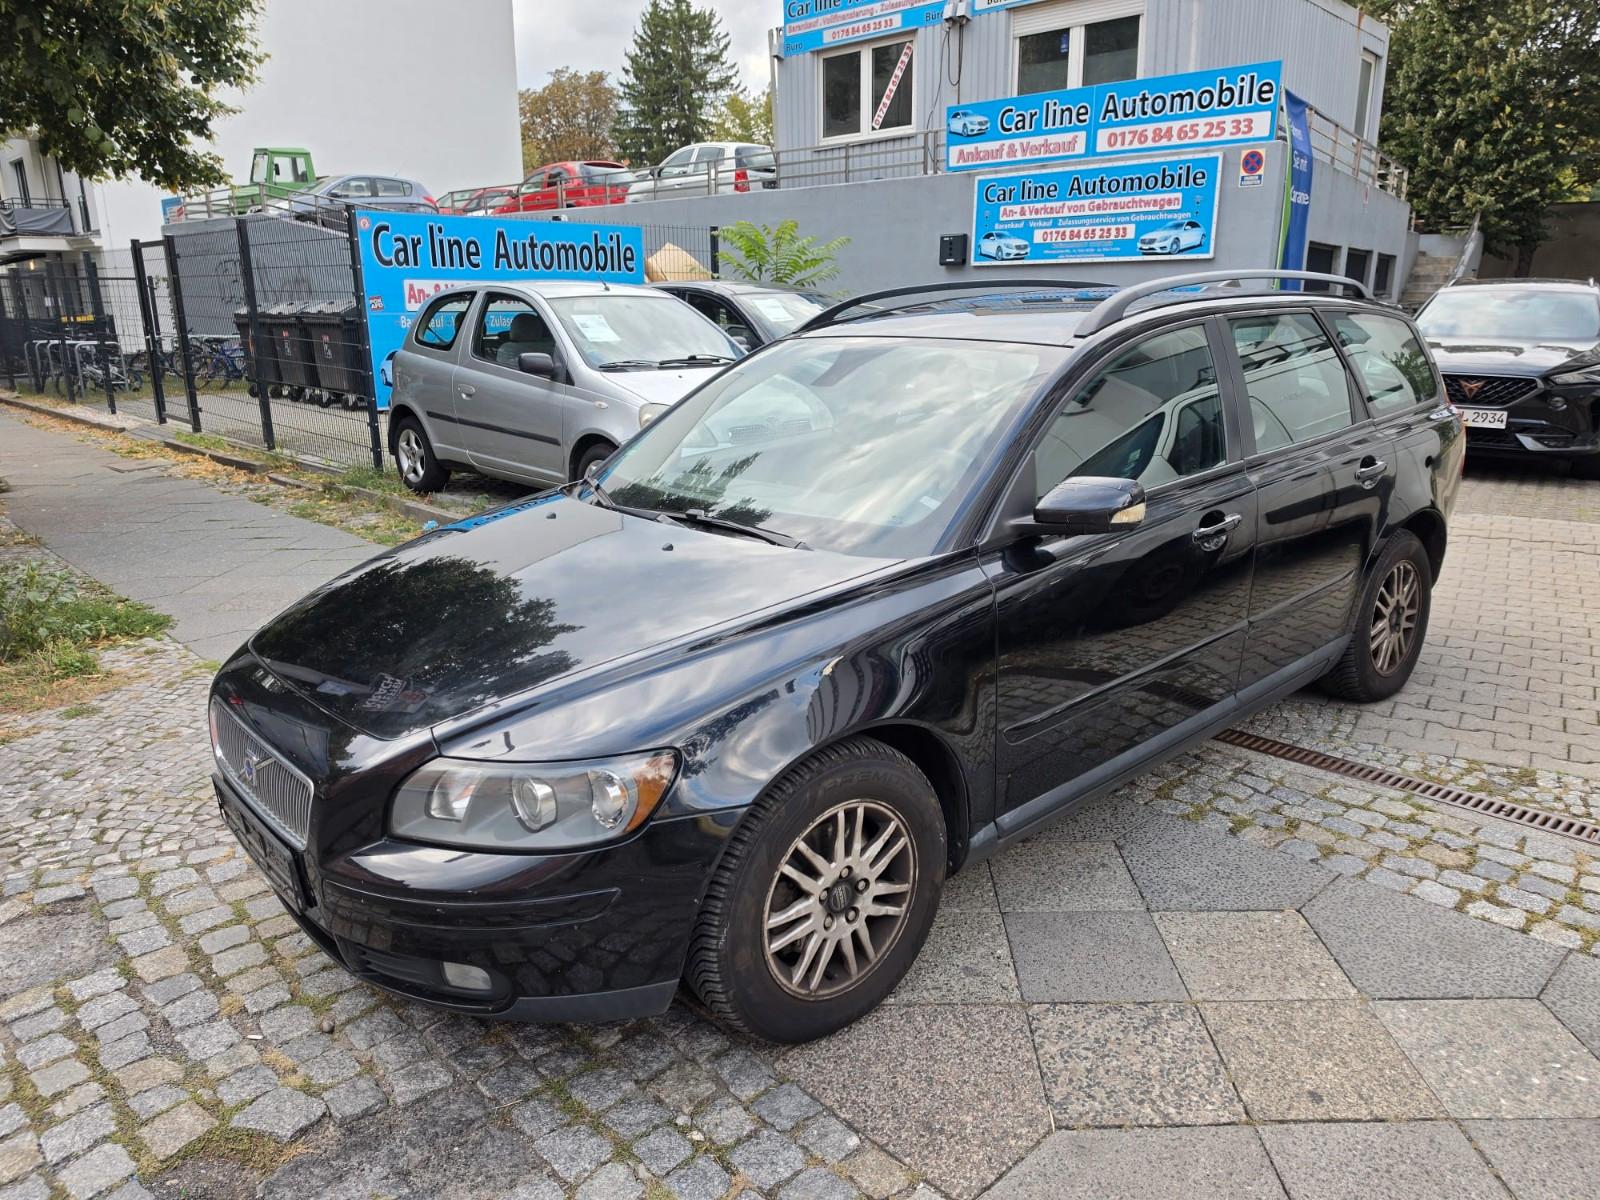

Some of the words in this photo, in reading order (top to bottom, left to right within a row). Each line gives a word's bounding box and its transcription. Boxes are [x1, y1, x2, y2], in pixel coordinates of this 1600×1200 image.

[787, 1, 811, 18] Car
[832, 28, 850, 40] 0176
[851, 25, 860, 35] 84
[862, 23, 871, 33] 65
[873, 21, 882, 31] 25
[884, 18, 893, 29] 33
[999, 107, 1038, 133] Car
[1044, 100, 1090, 128] line
[1100, 74, 1275, 121] Automobile
[1107, 129, 1149, 148] 0176
[1151, 126, 1174, 143] 84
[1177, 123, 1199, 141] 65
[1202, 120, 1226, 139] 25
[1229, 118, 1254, 136] 33
[956, 143, 1005, 164] Ankauf
[1006, 142, 1018, 158] &
[1020, 134, 1078, 157] Verkauf
[984, 184, 1015, 203] Car
[1021, 179, 1058, 200] line
[1067, 164, 1207, 197] Automobile
[1001, 207, 1018, 218] An-
[1019, 206, 1027, 217] &
[1028, 203, 1066, 216] Verkauf
[1067, 204, 1086, 213] von
[1087, 196, 1181, 213] Gebrauchtwagen
[1130, 212, 1192, 222] Gebrauchtwagen
[1042, 230, 1067, 242] 0176
[1069, 229, 1082, 240] 84
[1083, 228, 1096, 239] 65
[1099, 227, 1112, 238] 25
[1114, 226, 1128, 238] 33
[372, 223, 422, 269] Car
[428, 224, 481, 269] line
[494, 229, 635, 273] Automobile
[407, 283, 431, 304] An-
[1472, 411, 1505, 423] 2934
